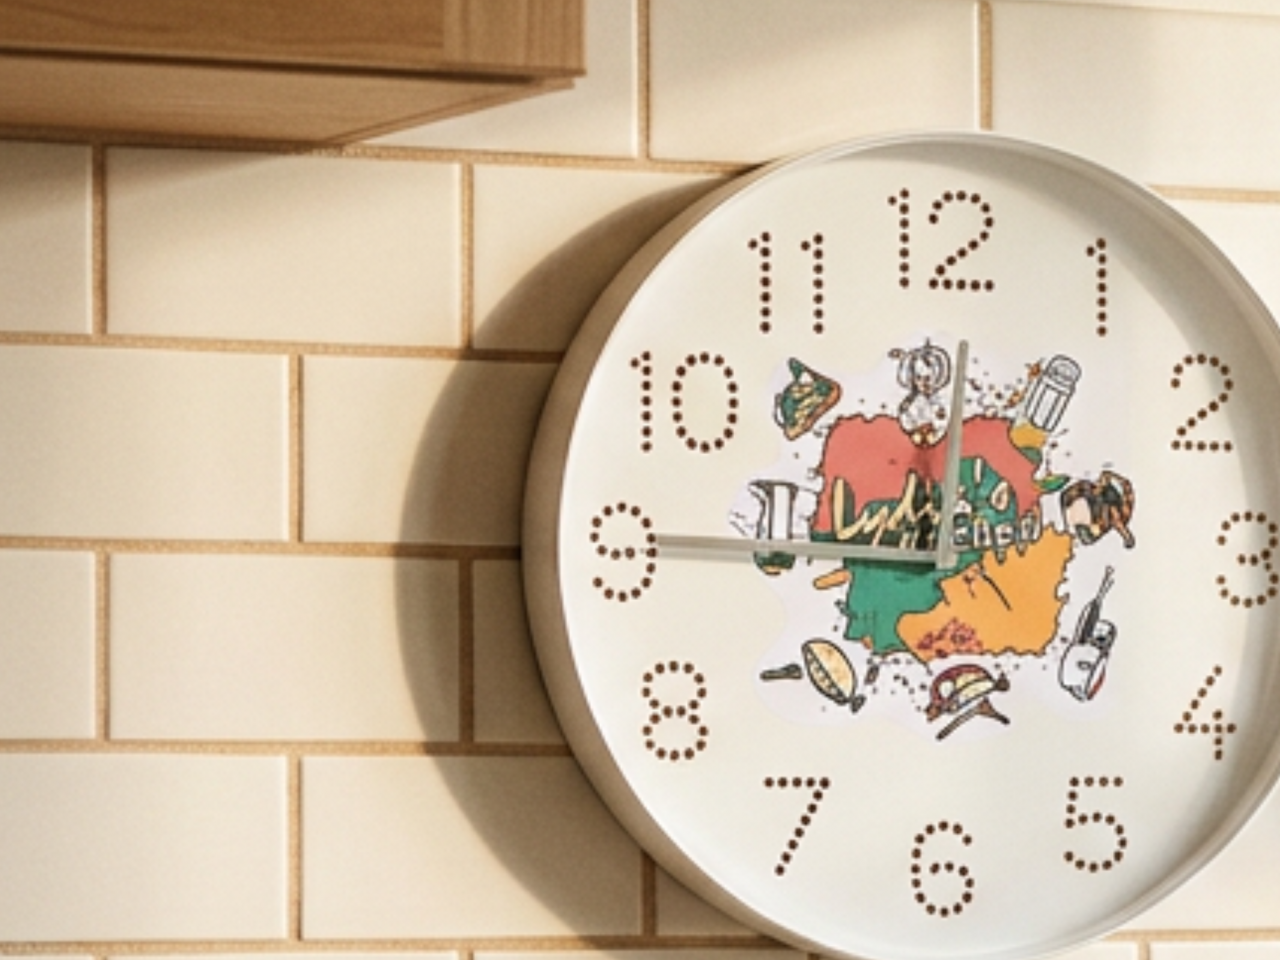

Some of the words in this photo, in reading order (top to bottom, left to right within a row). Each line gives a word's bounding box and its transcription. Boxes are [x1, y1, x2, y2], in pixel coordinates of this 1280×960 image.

[748, 232, 824, 334] 11
[888, 189, 994, 290] 12
[1086, 237, 1107, 336] 1
[630, 351, 738, 453] 10
[1171, 353, 1234, 452] 2
[590, 502, 658, 602] 9
[1218, 511, 1279, 608] 3
[643, 661, 708, 761] 8
[1174, 665, 1237, 761] 4
[764, 777, 830, 876] 7
[911, 821, 974, 917] 6
[1064, 776, 1127, 873] 5
